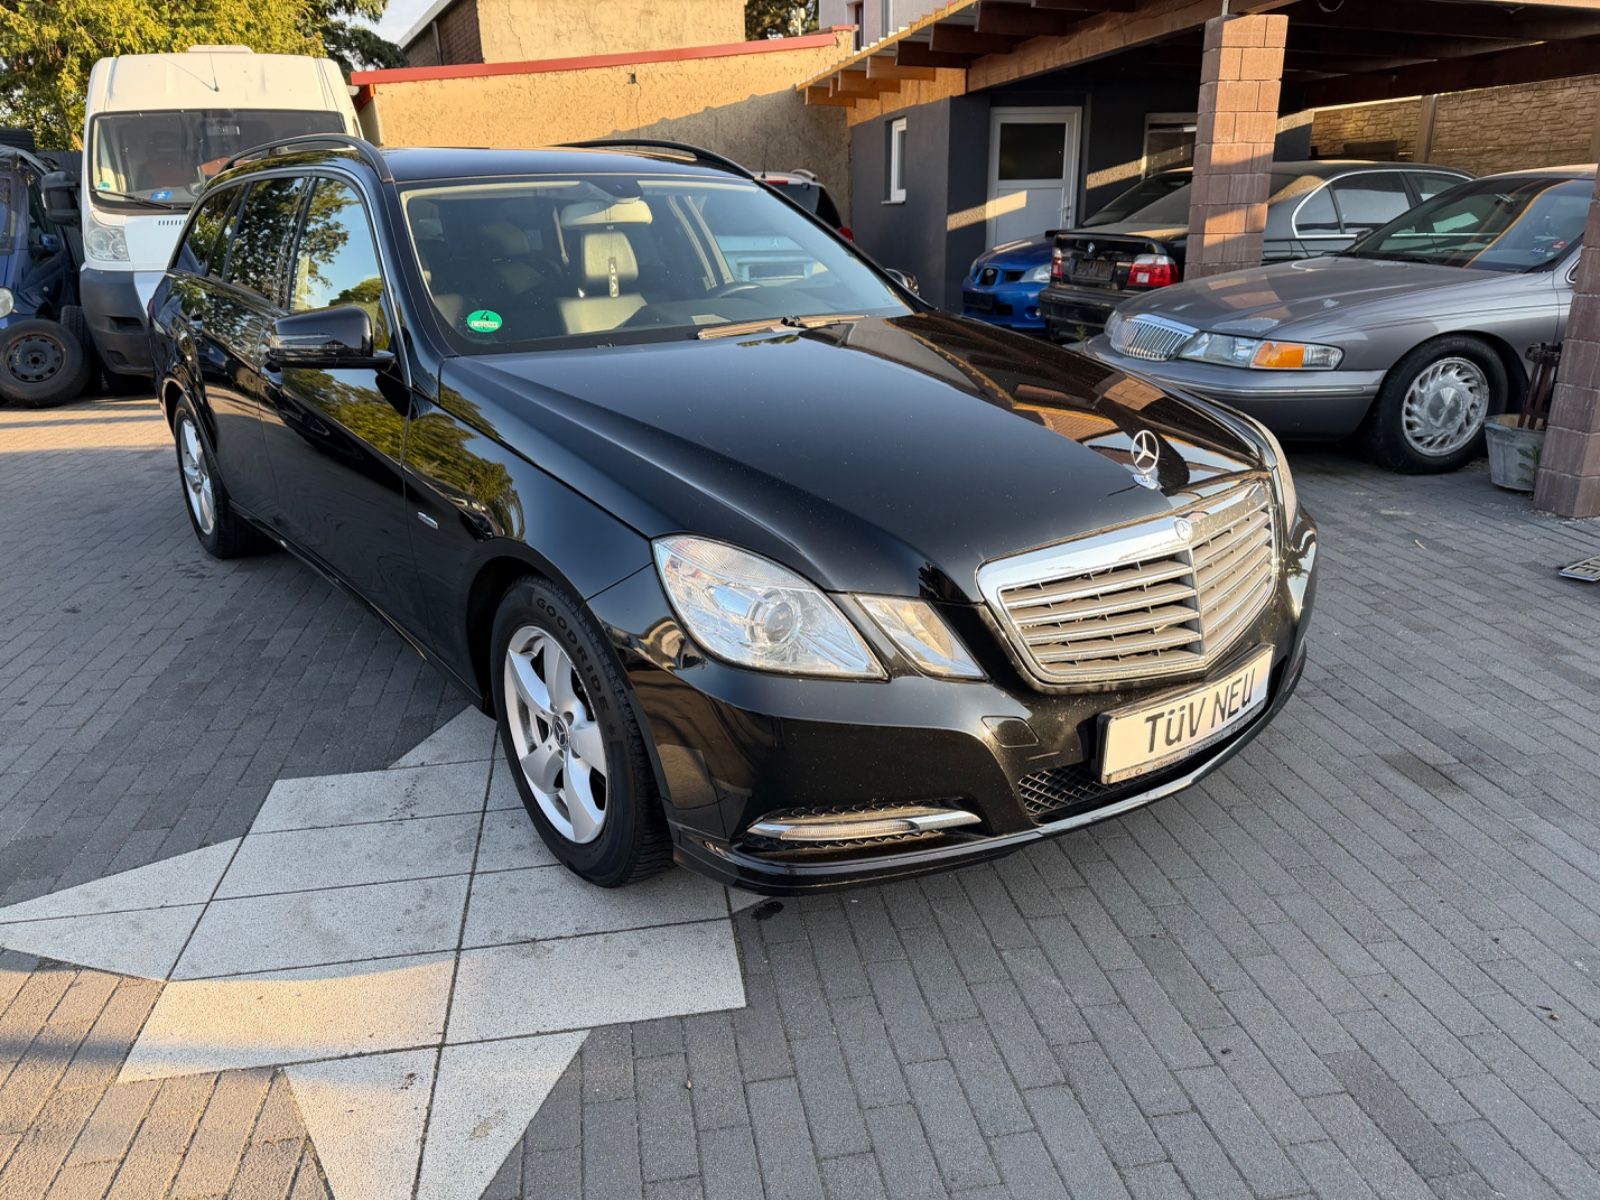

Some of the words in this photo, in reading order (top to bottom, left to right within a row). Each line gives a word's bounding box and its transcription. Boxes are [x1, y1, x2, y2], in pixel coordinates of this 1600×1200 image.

[480, 311, 490, 322] 4
[537, 598, 609, 711] GOODRIDE
[1210, 667, 1256, 729] NEU
